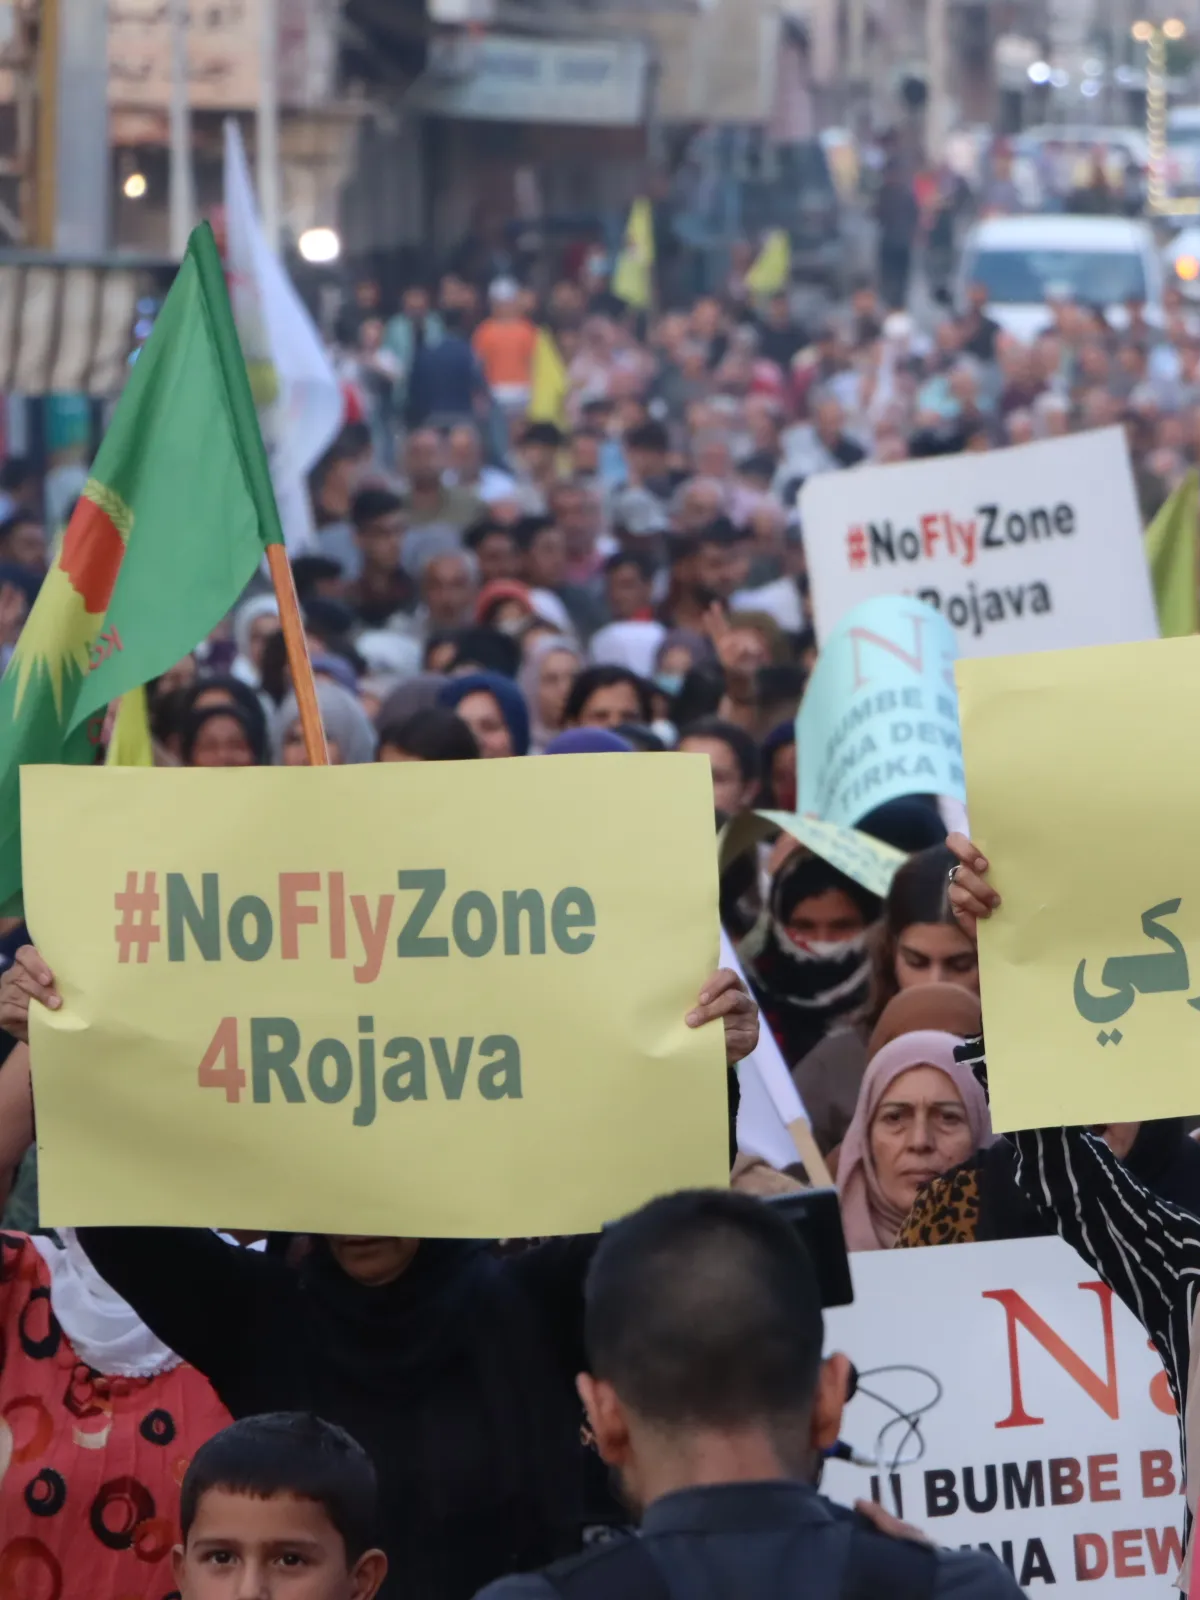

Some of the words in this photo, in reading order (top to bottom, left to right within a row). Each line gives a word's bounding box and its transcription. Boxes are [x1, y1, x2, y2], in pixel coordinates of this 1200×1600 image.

[845, 501, 1076, 569] #NoFlyZone
[115, 868, 596, 984] #NoFlyZone
[198, 1015, 523, 1127] 4Rojava
[923, 1452, 1122, 1518] BUMBE
